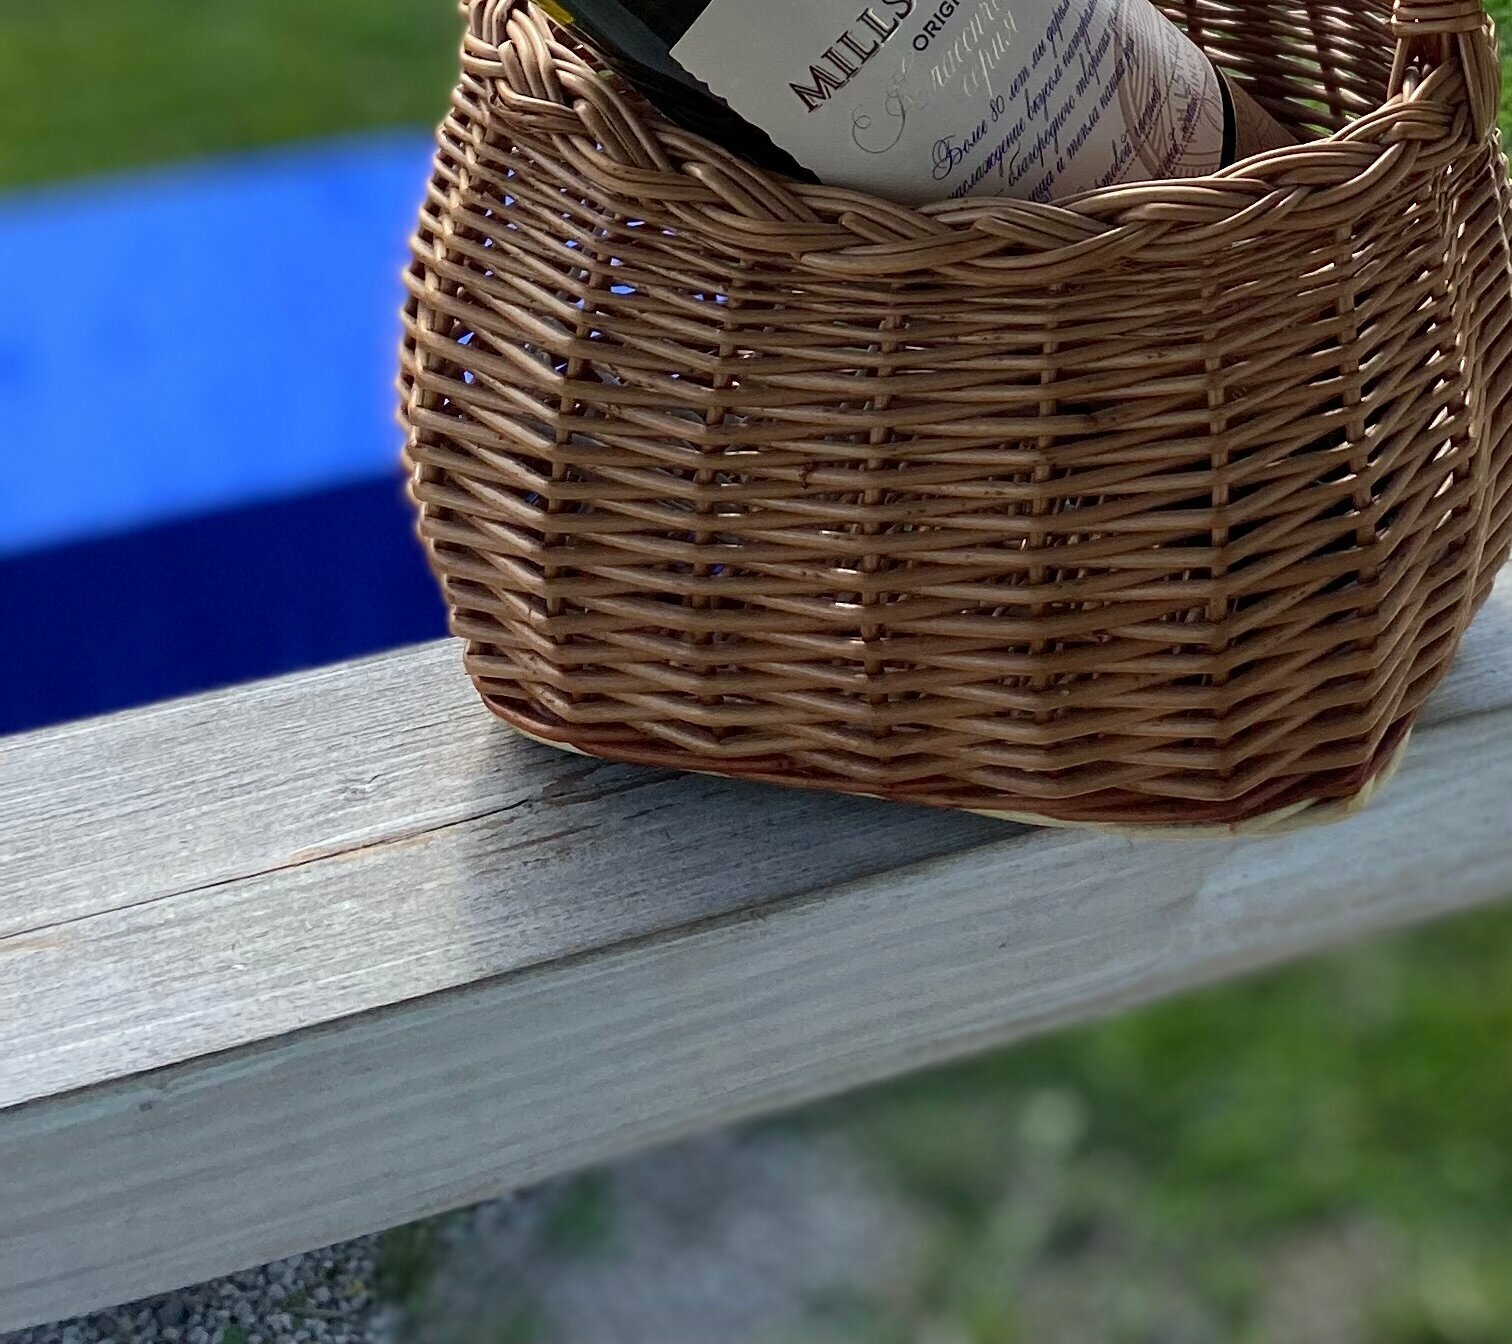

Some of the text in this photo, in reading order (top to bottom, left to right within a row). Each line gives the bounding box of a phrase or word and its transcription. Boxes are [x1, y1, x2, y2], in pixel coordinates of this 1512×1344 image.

[963, 11, 1018, 98] серия
[1025, 64, 1062, 122] вкусом
[932, 120, 987, 180] Более
[990, 95, 1005, 122] 80
[1009, 66, 1030, 101] лет
[1032, 38, 1046, 69] мы
[1008, 94, 1075, 186] благородного
[1057, 157, 1065, 173] и
[1067, 106, 1100, 161] тепла
